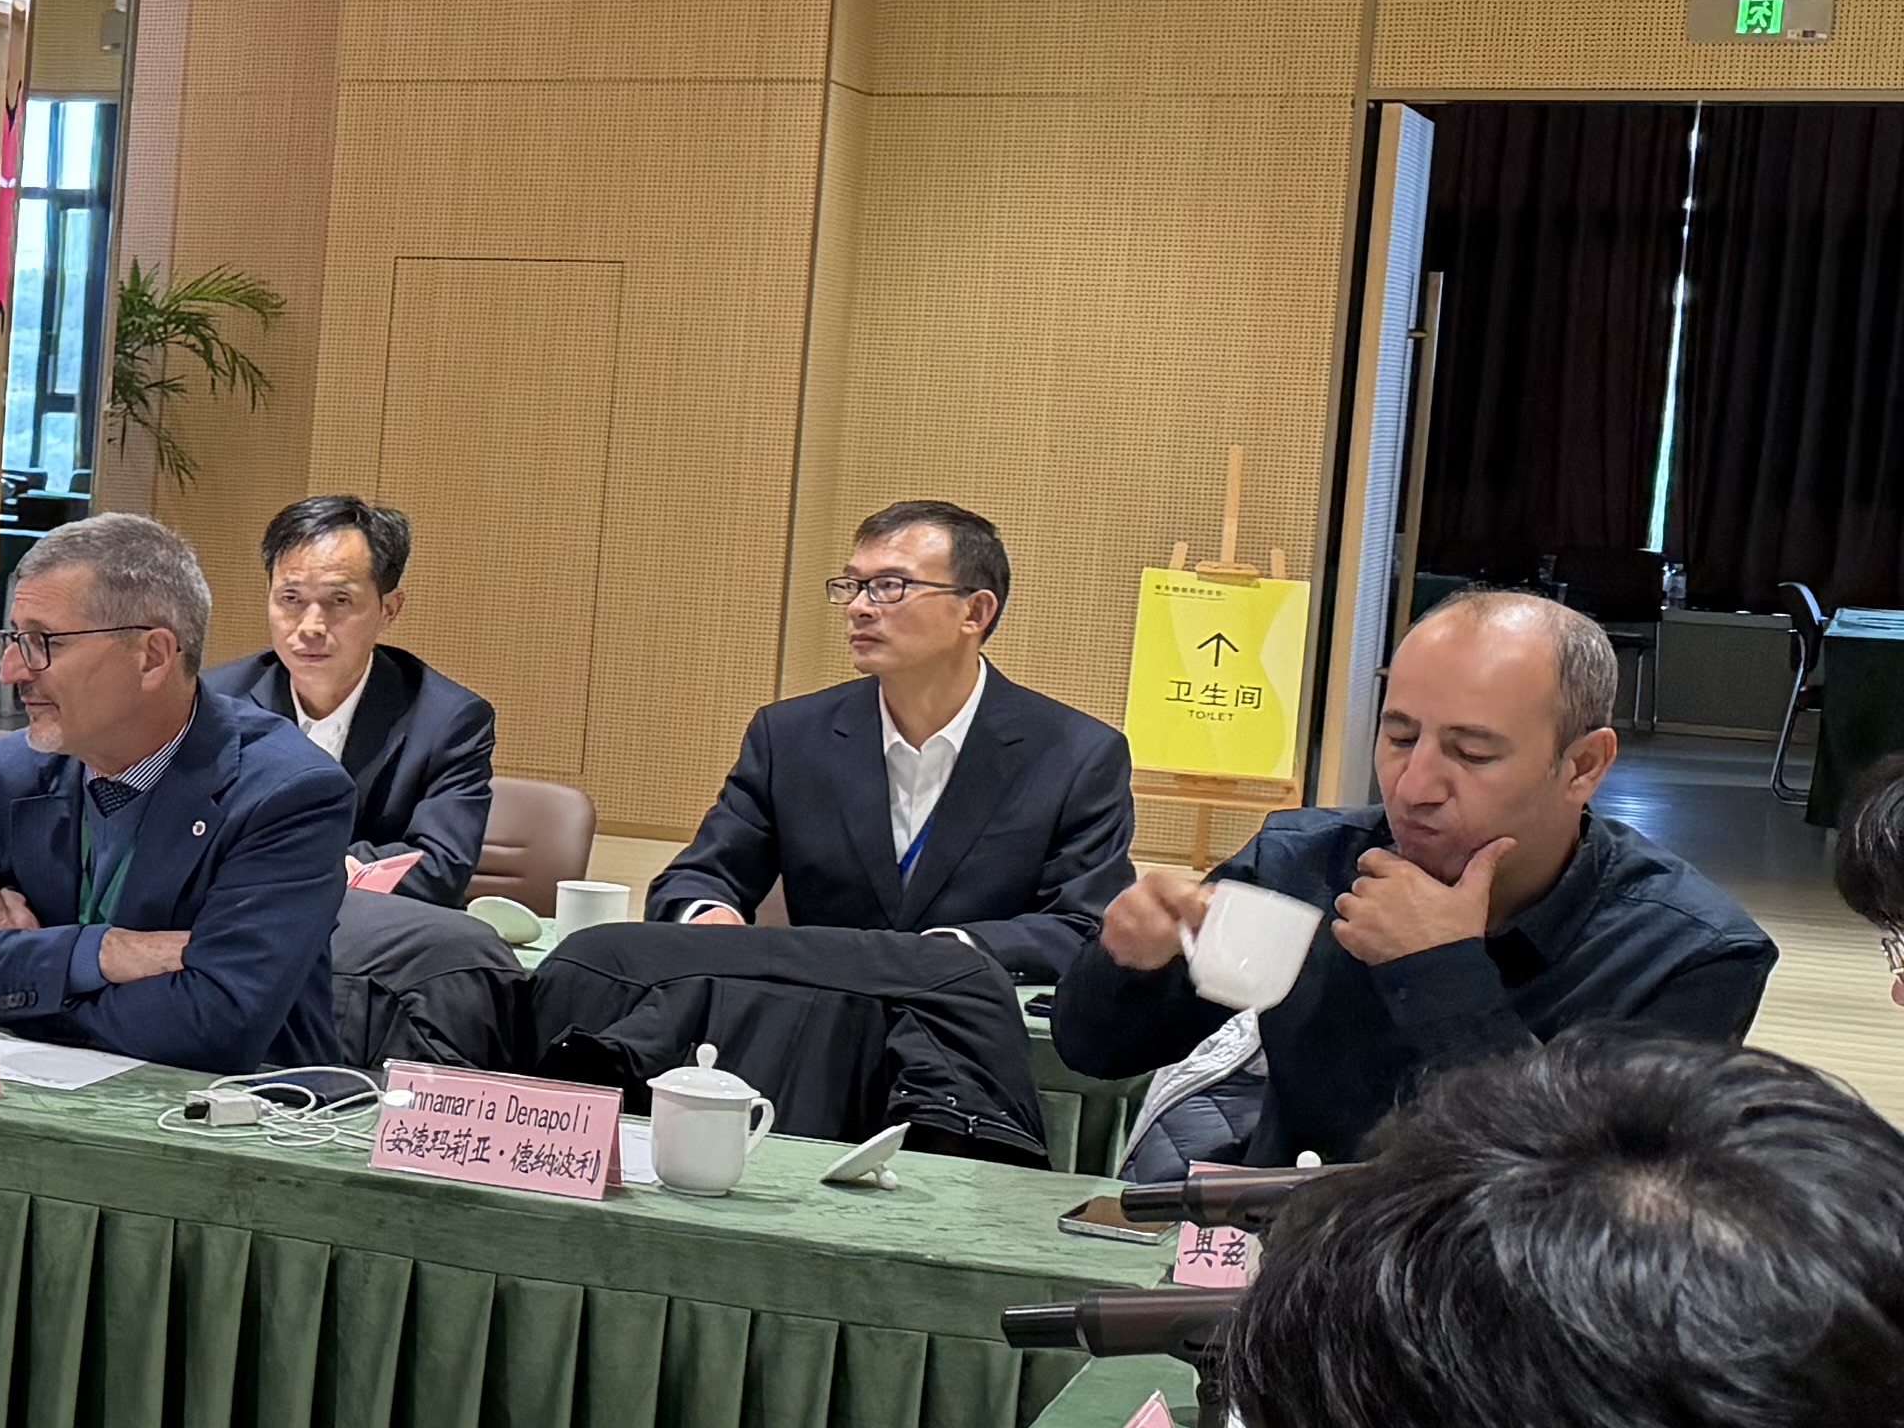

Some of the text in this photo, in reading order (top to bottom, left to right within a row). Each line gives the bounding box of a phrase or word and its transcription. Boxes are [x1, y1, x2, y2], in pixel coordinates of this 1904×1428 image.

[1165, 679, 1262, 709] 卫生间
[1188, 710, 1234, 721] TOILET
[506, 1094, 592, 1136] Denapoli
